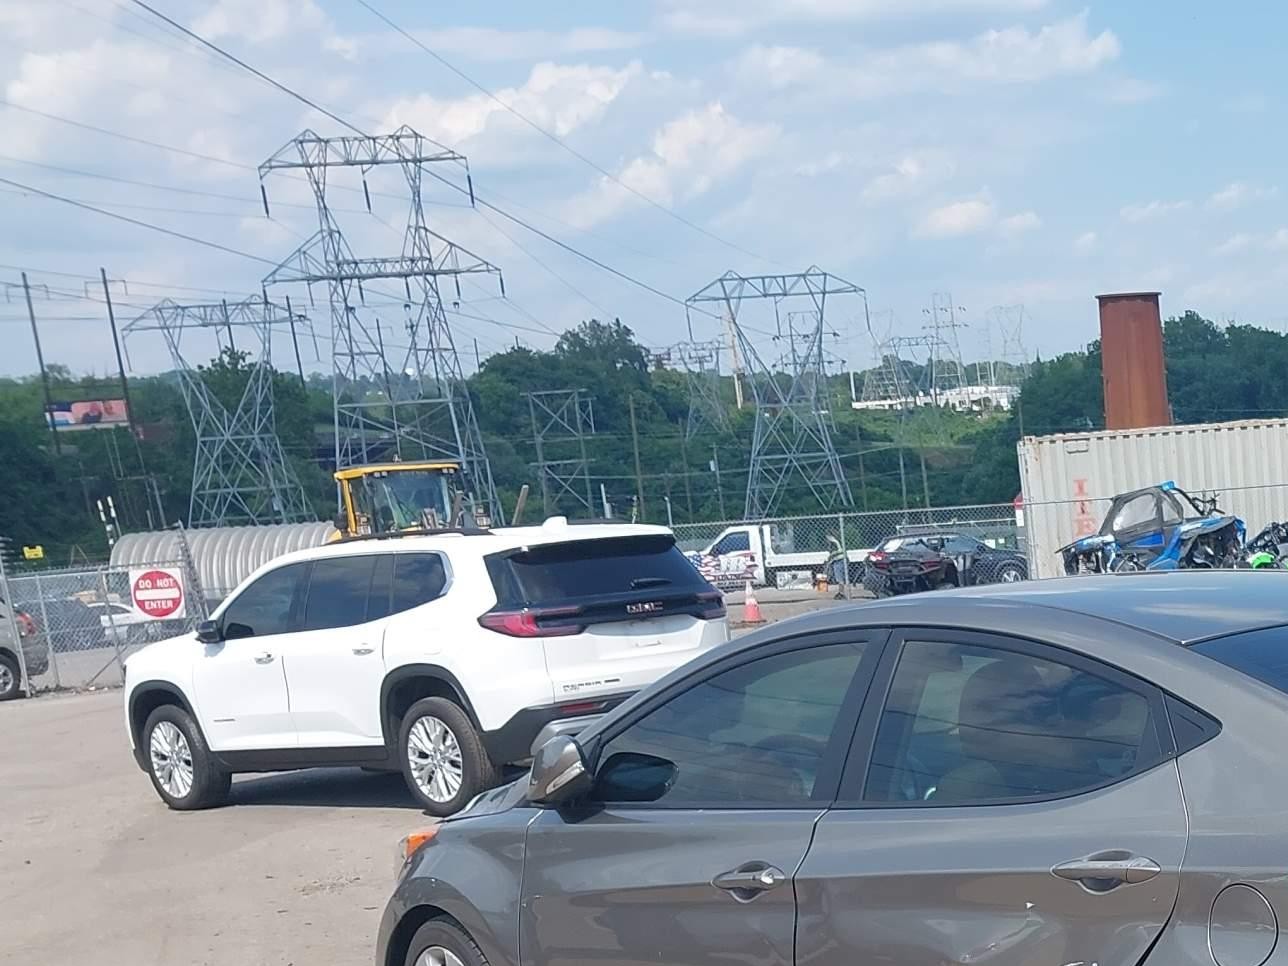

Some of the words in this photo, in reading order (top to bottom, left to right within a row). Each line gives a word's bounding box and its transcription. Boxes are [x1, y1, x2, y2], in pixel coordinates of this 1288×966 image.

[138, 579, 153, 589] DO
[156, 578, 176, 588] NOT
[144, 600, 174, 610] ENTER
